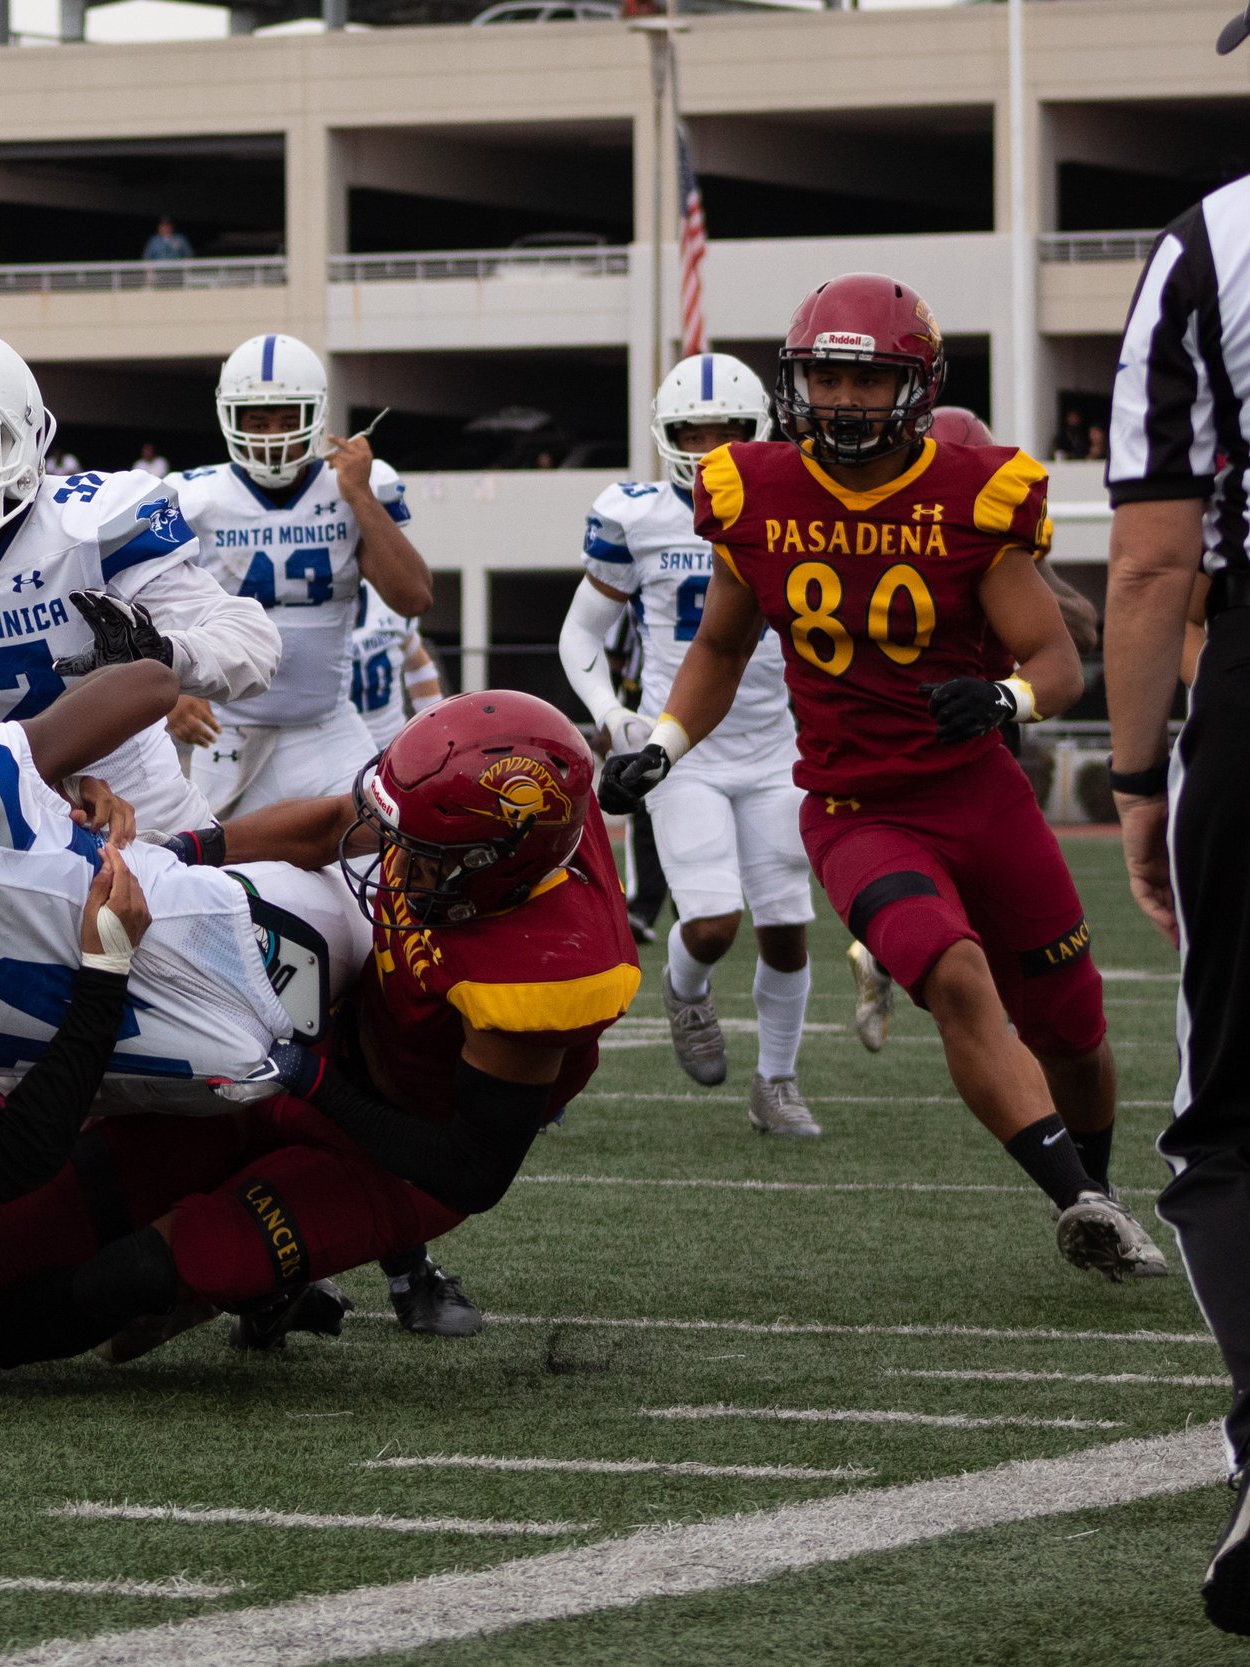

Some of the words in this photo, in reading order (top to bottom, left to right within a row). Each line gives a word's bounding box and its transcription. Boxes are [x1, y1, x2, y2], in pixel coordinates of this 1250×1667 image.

[829, 334, 862, 346] Riddell
[215, 527, 273, 547] SANTA
[279, 522, 348, 544] MONICA
[765, 519, 948, 557] PASADENA
[237, 547, 334, 609] 43
[786, 561, 937, 677] 80
[246, 1185, 300, 1278] LANCERS
